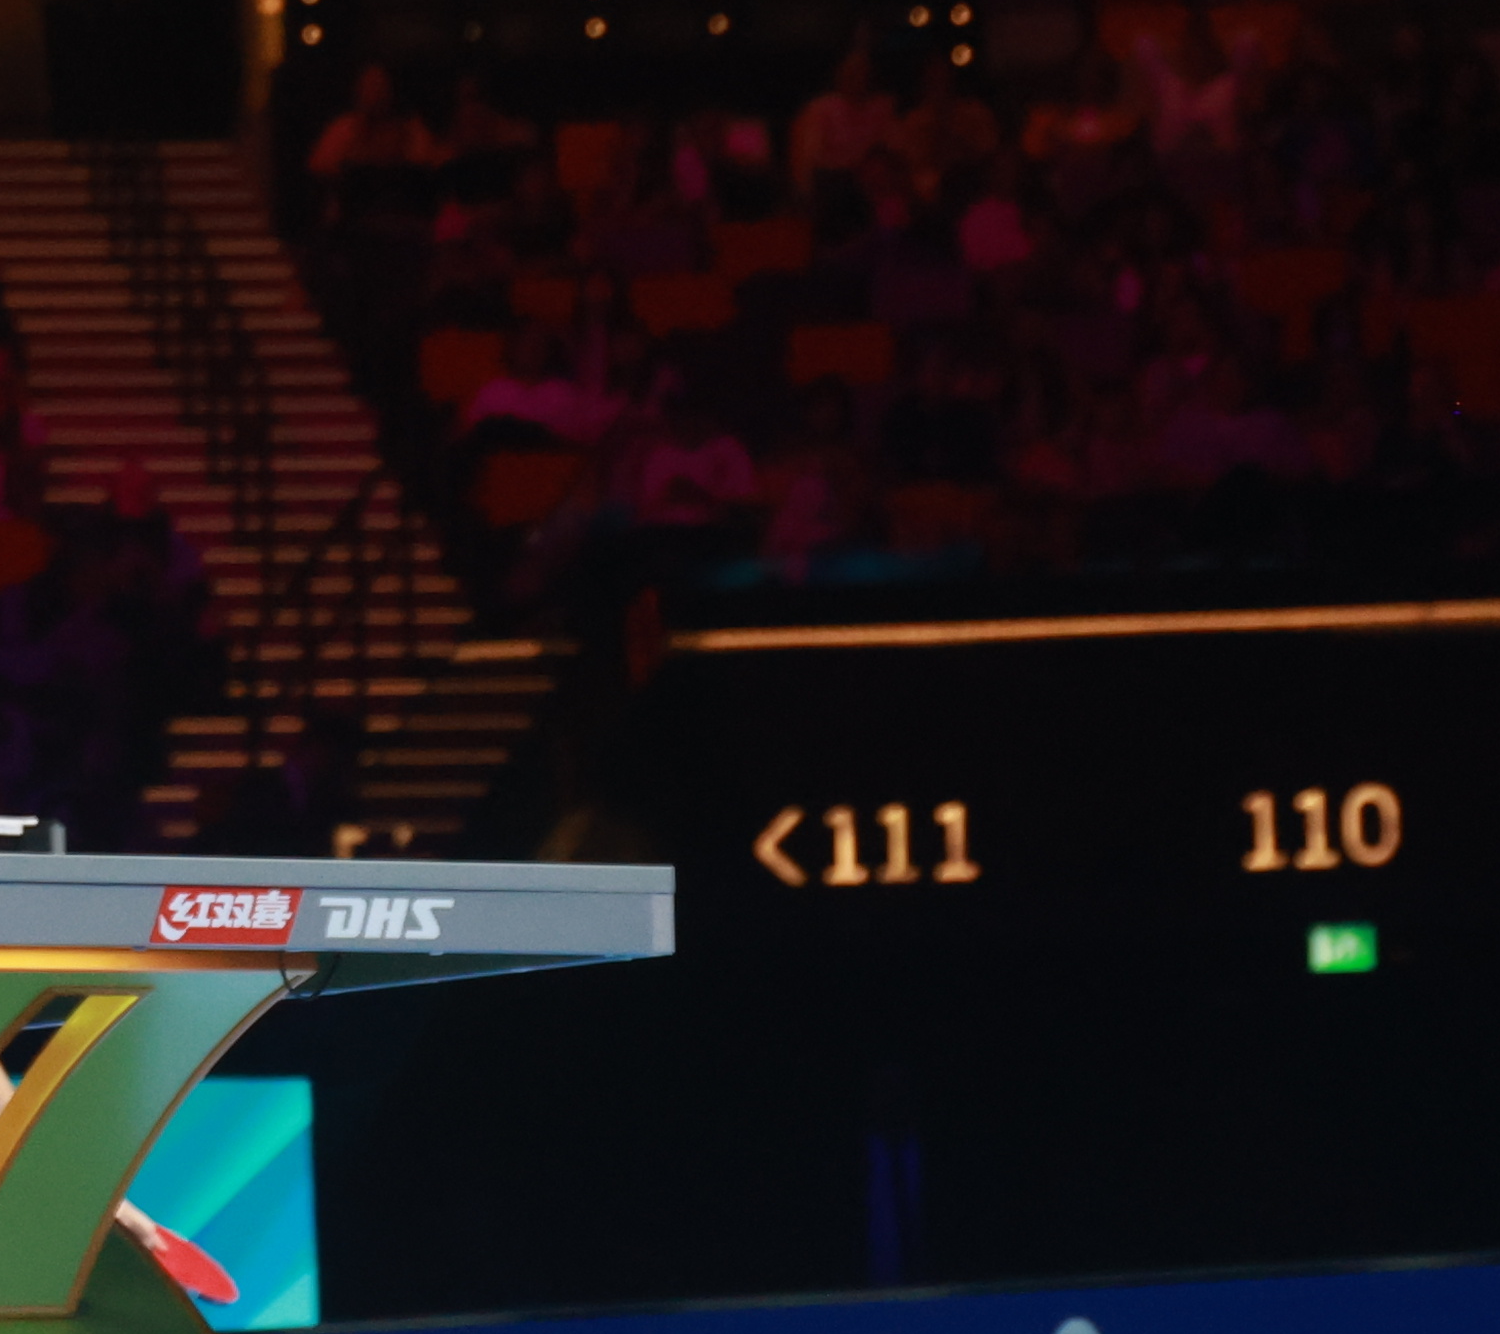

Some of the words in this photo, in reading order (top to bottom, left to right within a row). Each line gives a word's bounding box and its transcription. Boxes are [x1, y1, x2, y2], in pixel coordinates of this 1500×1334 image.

[822, 800, 980, 885] 111
[1242, 783, 1402, 873] 110
[158, 889, 293, 941] 红双喜
[319, 897, 455, 940] DHS
